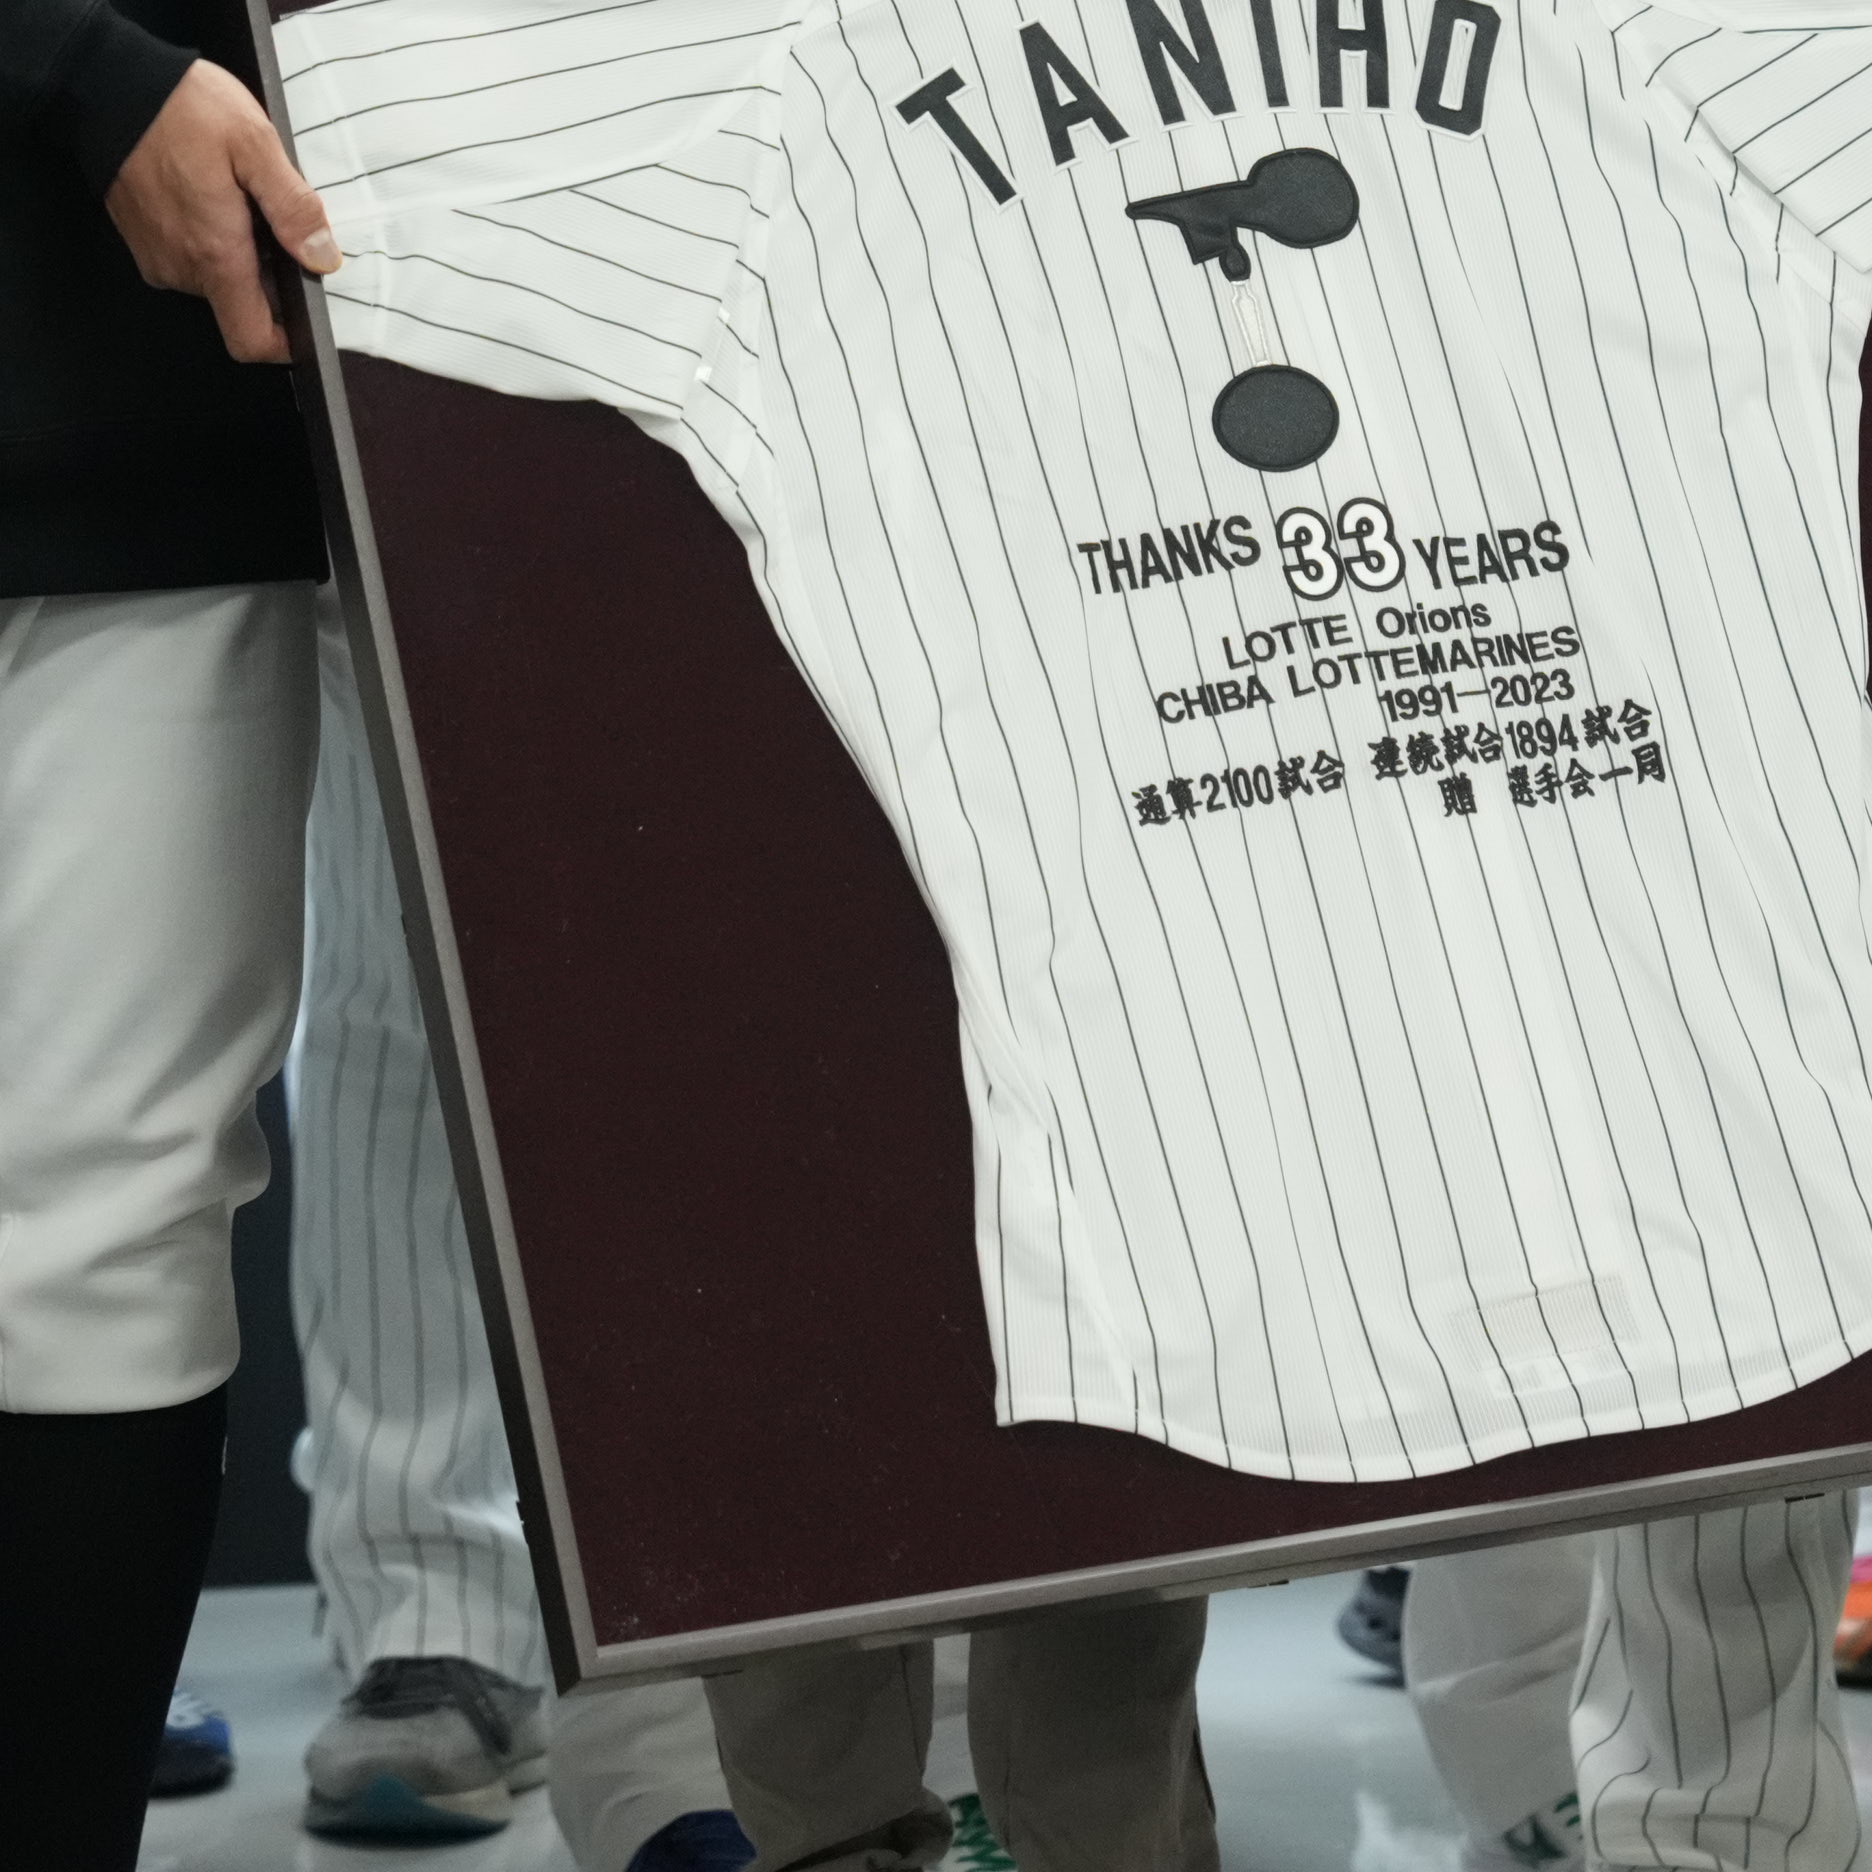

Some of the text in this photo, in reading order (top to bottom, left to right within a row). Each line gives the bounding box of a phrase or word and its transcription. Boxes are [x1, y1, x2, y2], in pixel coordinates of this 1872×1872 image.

[1077, 497, 1571, 601] THANKS 33 YEARS
[1156, 624, 1581, 724] CHIBA LOTTEMARINES
[1222, 602, 1492, 670] LOTTE Orions
[1131, 749, 1346, 827] 通算2100試合
